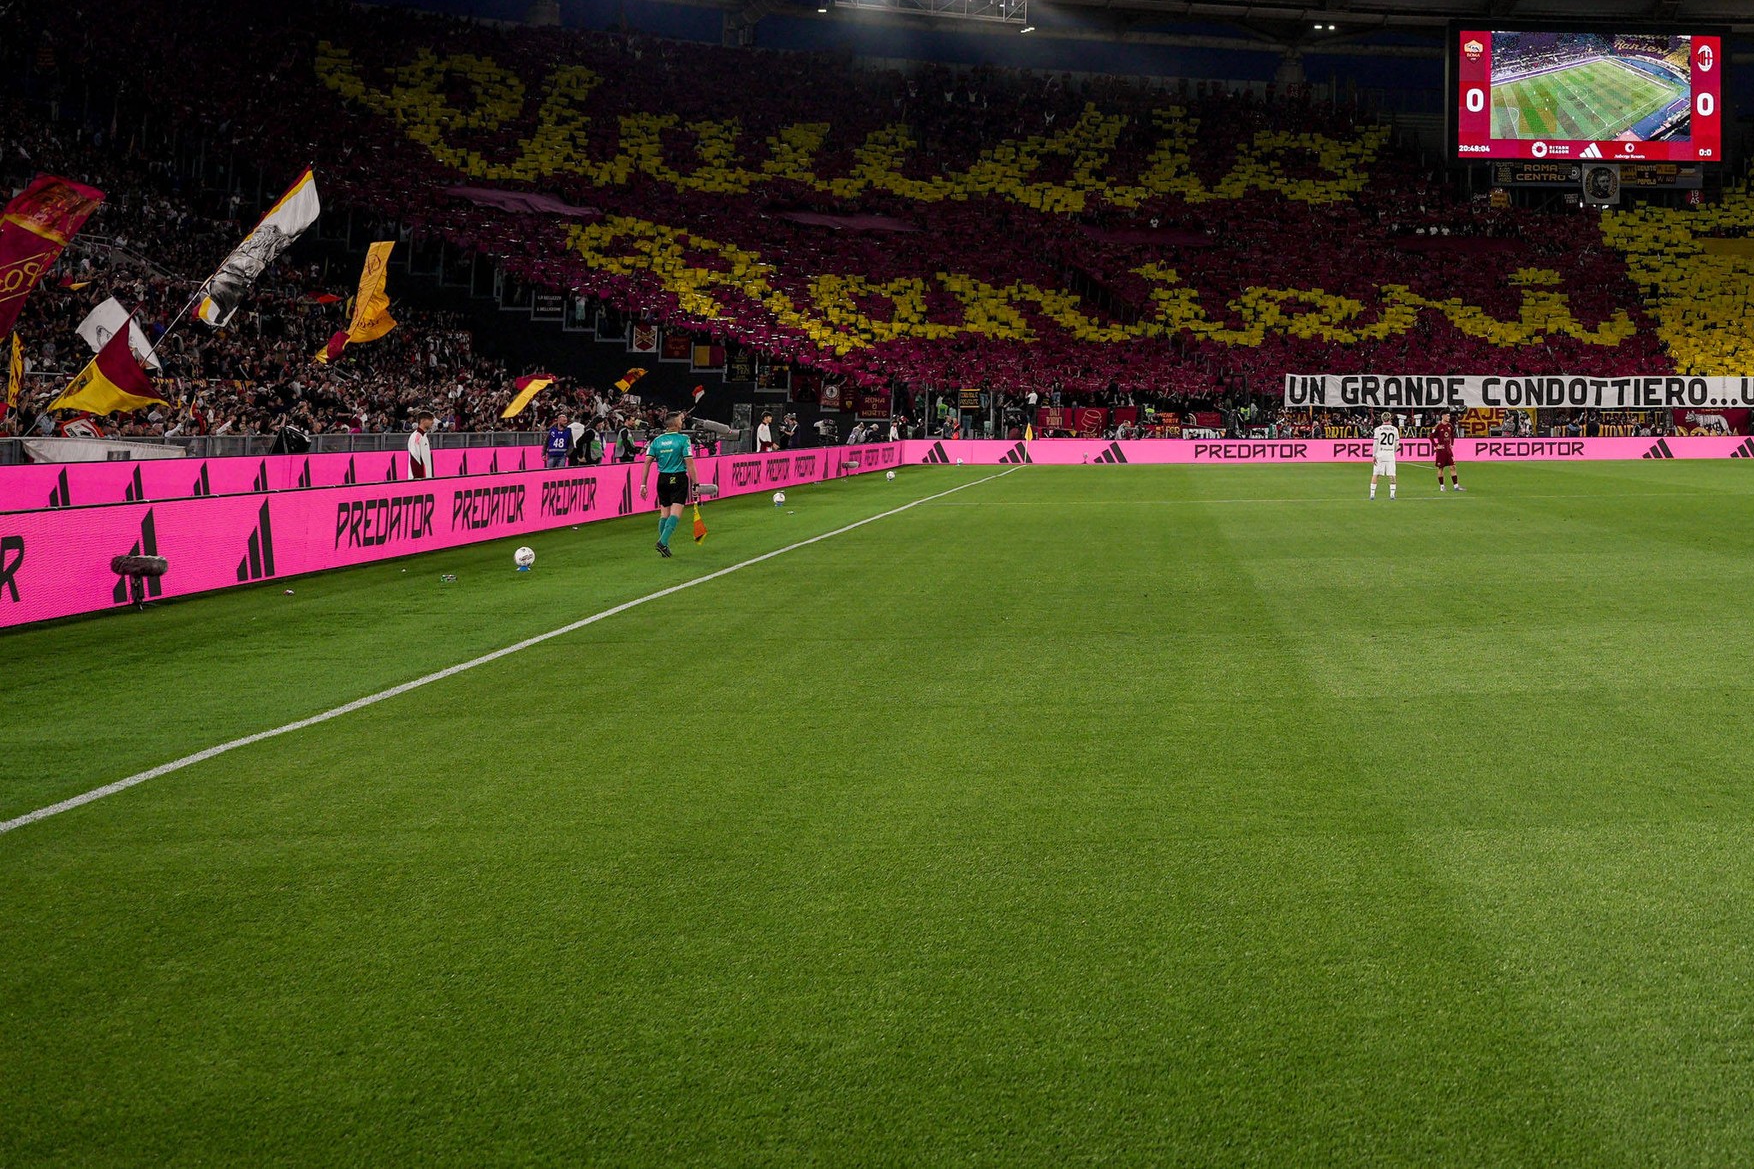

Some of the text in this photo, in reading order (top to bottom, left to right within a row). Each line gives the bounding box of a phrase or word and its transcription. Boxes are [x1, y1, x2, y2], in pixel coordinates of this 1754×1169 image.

[1466, 88, 1485, 113] 0
[1696, 92, 1715, 117] 0
[1523, 163, 1559, 172] ROMA
[1288, 376, 1326, 405] UN
[1341, 376, 1464, 405] GRANDE
[553, 438, 564, 448] 48
[1380, 432, 1394, 445] 20
[1194, 441, 1585, 459] PREDATOR PREATO PREDATOR
[335, 477, 597, 551] PREDATOR PREDATOR PREDATOR
